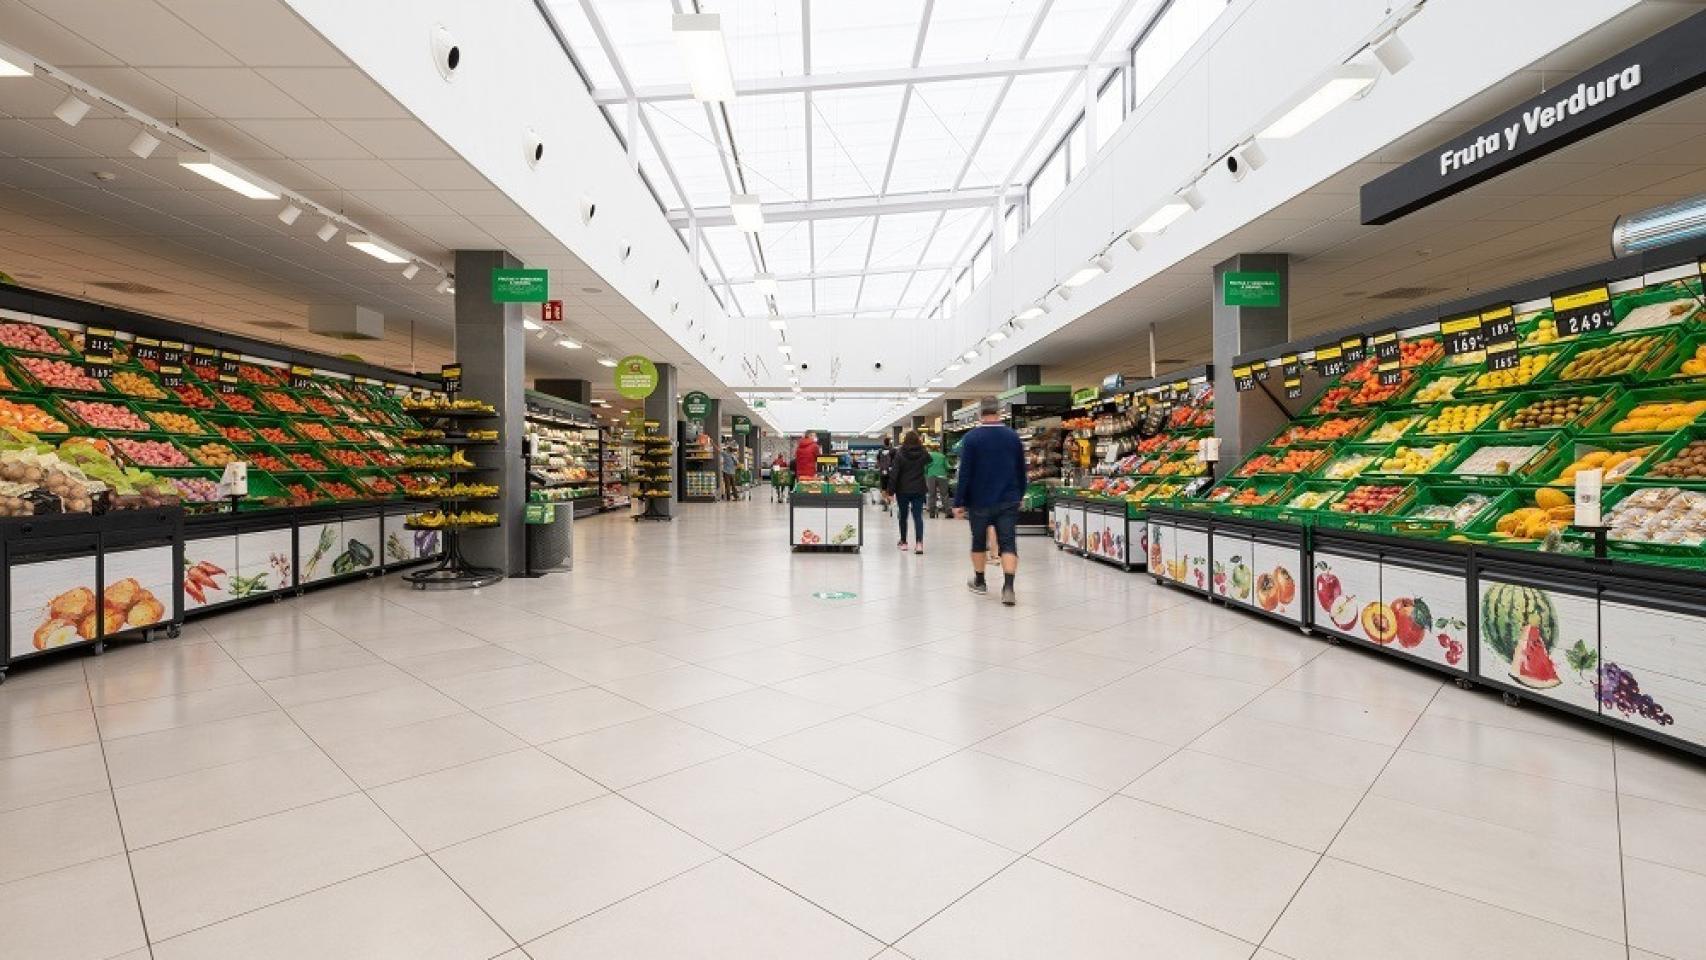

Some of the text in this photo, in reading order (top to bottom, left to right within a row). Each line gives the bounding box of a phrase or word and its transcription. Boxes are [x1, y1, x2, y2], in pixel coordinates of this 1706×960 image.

[1440, 63, 1642, 176] Fruta y Verdura
[1569, 312, 1601, 333] 249
[1453, 337, 1477, 353] 169
